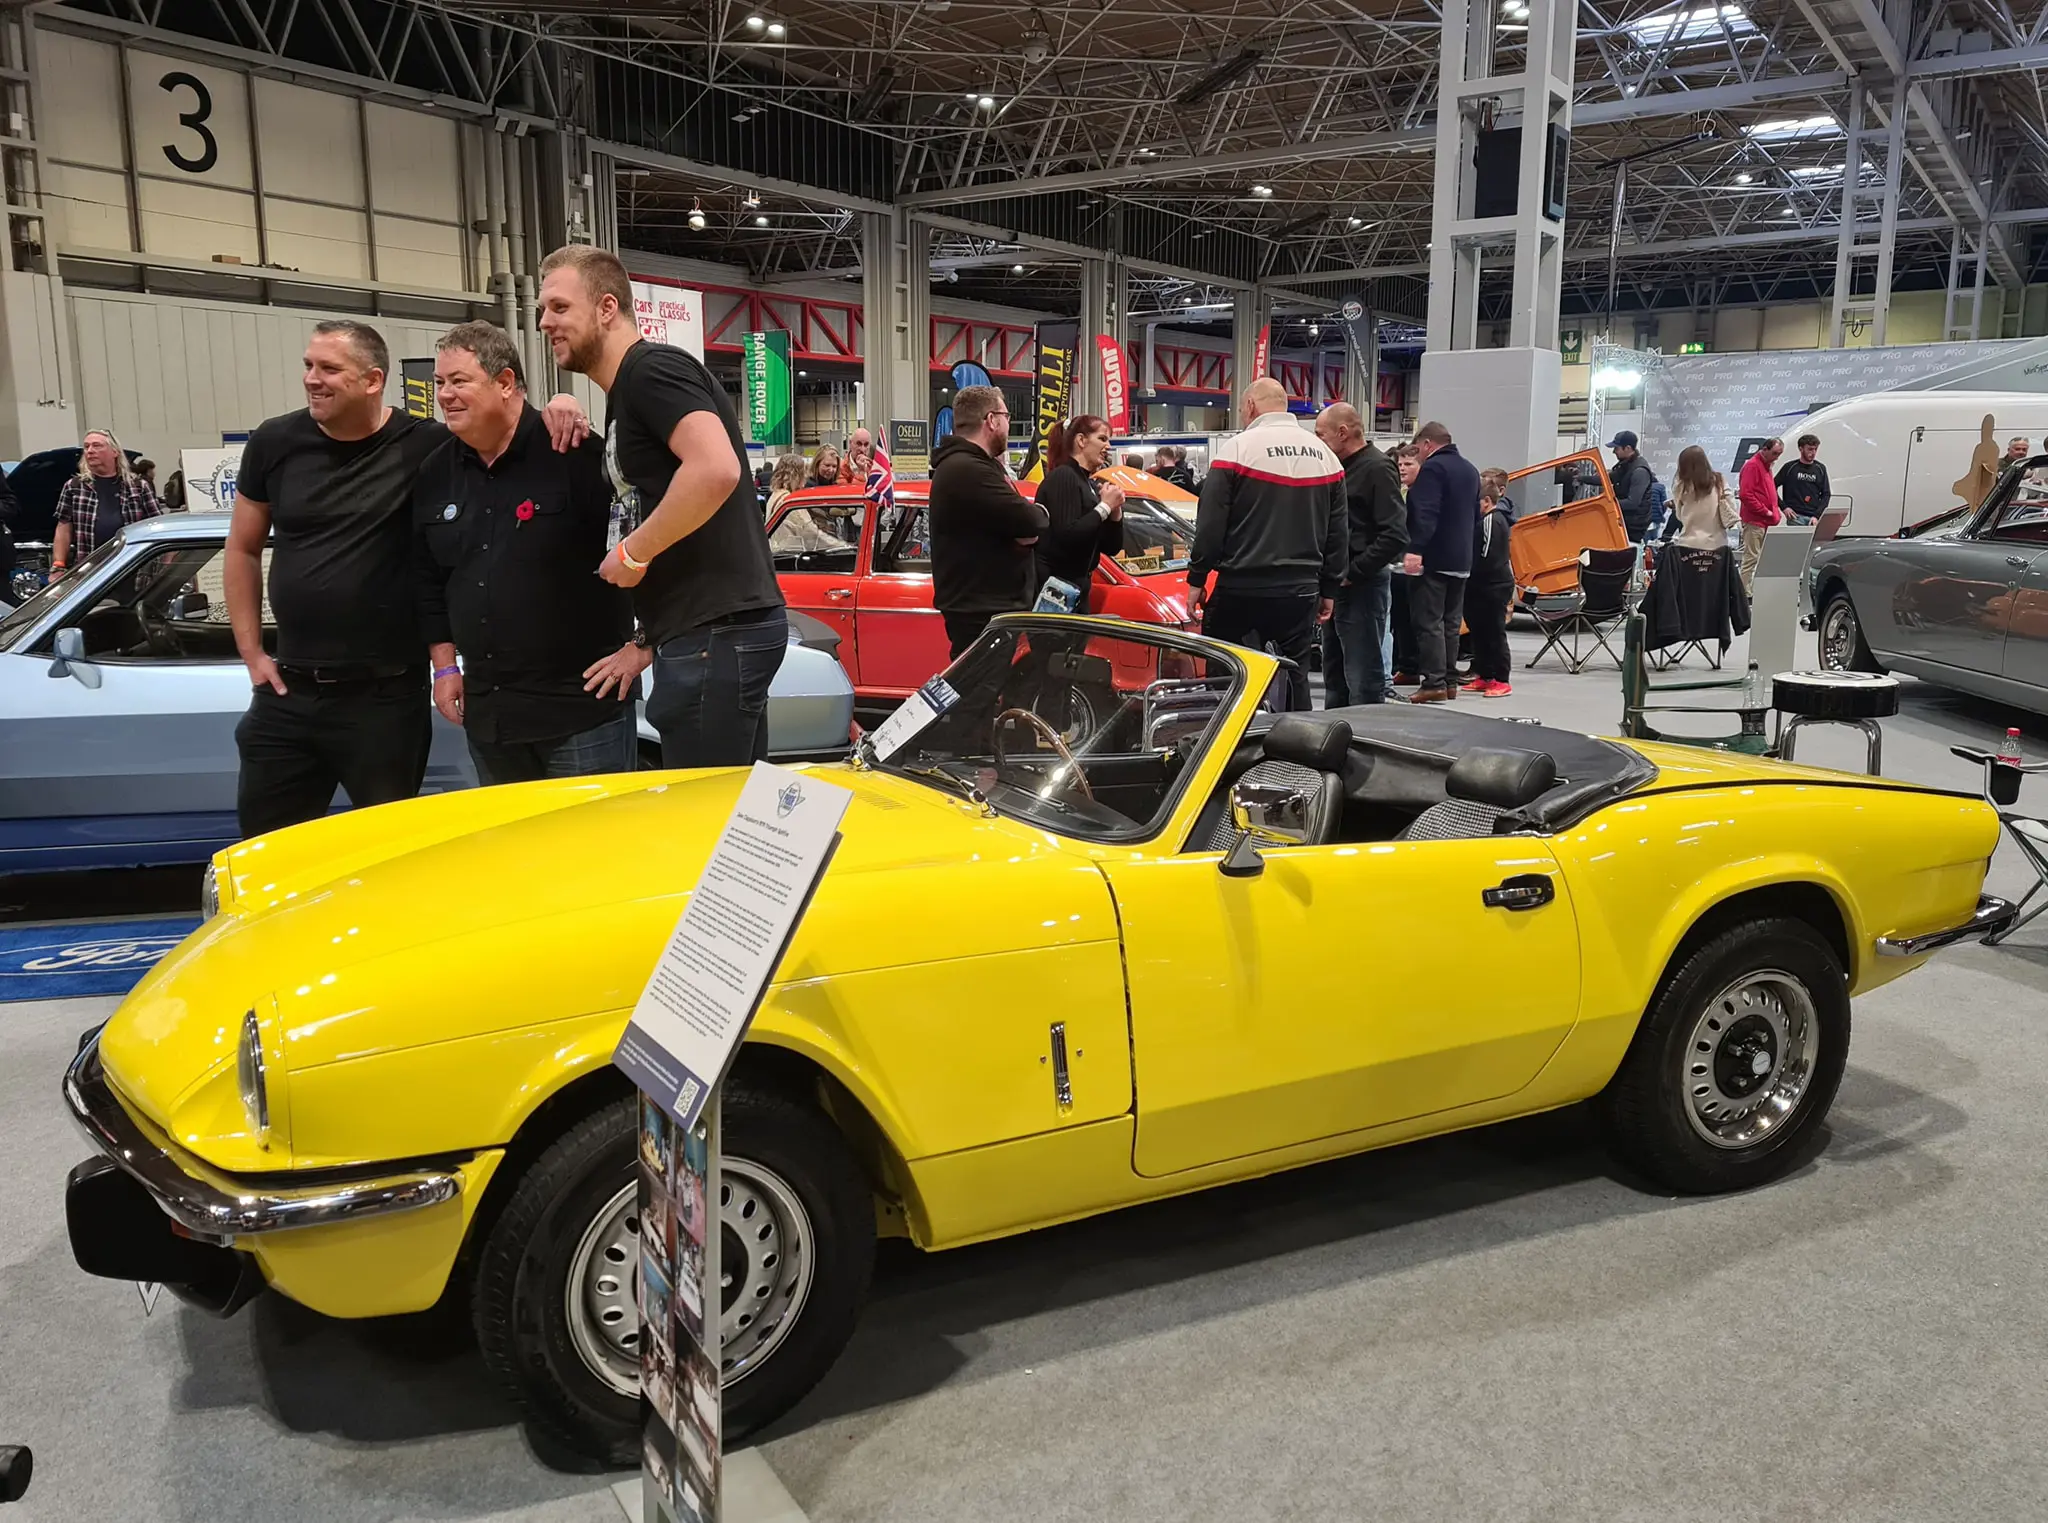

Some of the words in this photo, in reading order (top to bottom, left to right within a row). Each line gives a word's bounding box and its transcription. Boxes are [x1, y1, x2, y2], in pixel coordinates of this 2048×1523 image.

[158, 72, 218, 173] 3
[634, 299, 653, 313] Cars
[659, 301, 686, 311] practical
[660, 309, 691, 321] CLASSICS
[640, 325, 666, 339] CAR
[753, 332, 766, 378] RANGE
[1064, 348, 1074, 374] CARS
[1564, 352, 1578, 361] EXIT
[1730, 358, 1750, 366] PRG
[1759, 357, 1779, 365] PRG
[1788, 356, 1808, 364] PRG
[1850, 353, 1870, 361] PRG
[1881, 352, 1901, 360] PRG
[1912, 350, 1934, 358] PRG
[1945, 348, 1966, 356] PRG
[1977, 347, 1999, 355] PRG
[1660, 374, 1677, 382] PRG
[1686, 373, 1704, 381] PRG
[1714, 372, 1733, 380] PRG
[1772, 370, 1792, 378] PRG
[1802, 369, 1822, 377] PRG
[1832, 367, 1852, 375] PRG
[1863, 366, 1884, 374] PRG
[1895, 364, 1916, 373] PRG
[1926, 363, 1948, 371] PRG
[1672, 386, 1690, 394] PRG
[1700, 385, 1718, 393] PRG
[1728, 384, 1748, 392] PRG
[1757, 383, 1776, 391] PRG
[1786, 382, 1806, 390] PRG
[1816, 381, 1836, 389] PRG
[1847, 380, 1867, 388] PRG
[1878, 378, 1899, 386] PRG
[407, 377, 428, 418] LLI
[1060, 375, 1072, 413] SPORTS
[1770, 396, 1789, 404] PRG
[1799, 395, 1819, 403] PRG
[1830, 394, 1851, 402] PRG
[755, 381, 766, 424] ROVER
[1670, 412, 1688, 420] PRG
[1698, 411, 1716, 419] PRG
[1726, 410, 1745, 418] PRG
[1755, 409, 1774, 417] PRG
[897, 425, 922, 438] OSELLI
[1655, 424, 1673, 432] PRG
[1709, 423, 1729, 431] PRG
[1767, 422, 1788, 430] PRG
[1696, 436, 1714, 444] PRG
[1266, 446, 1323, 461] ENGLAND
[1797, 472, 1817, 480] BOSS
[220, 481, 237, 500] PR
[22, 940, 182, 970] For
